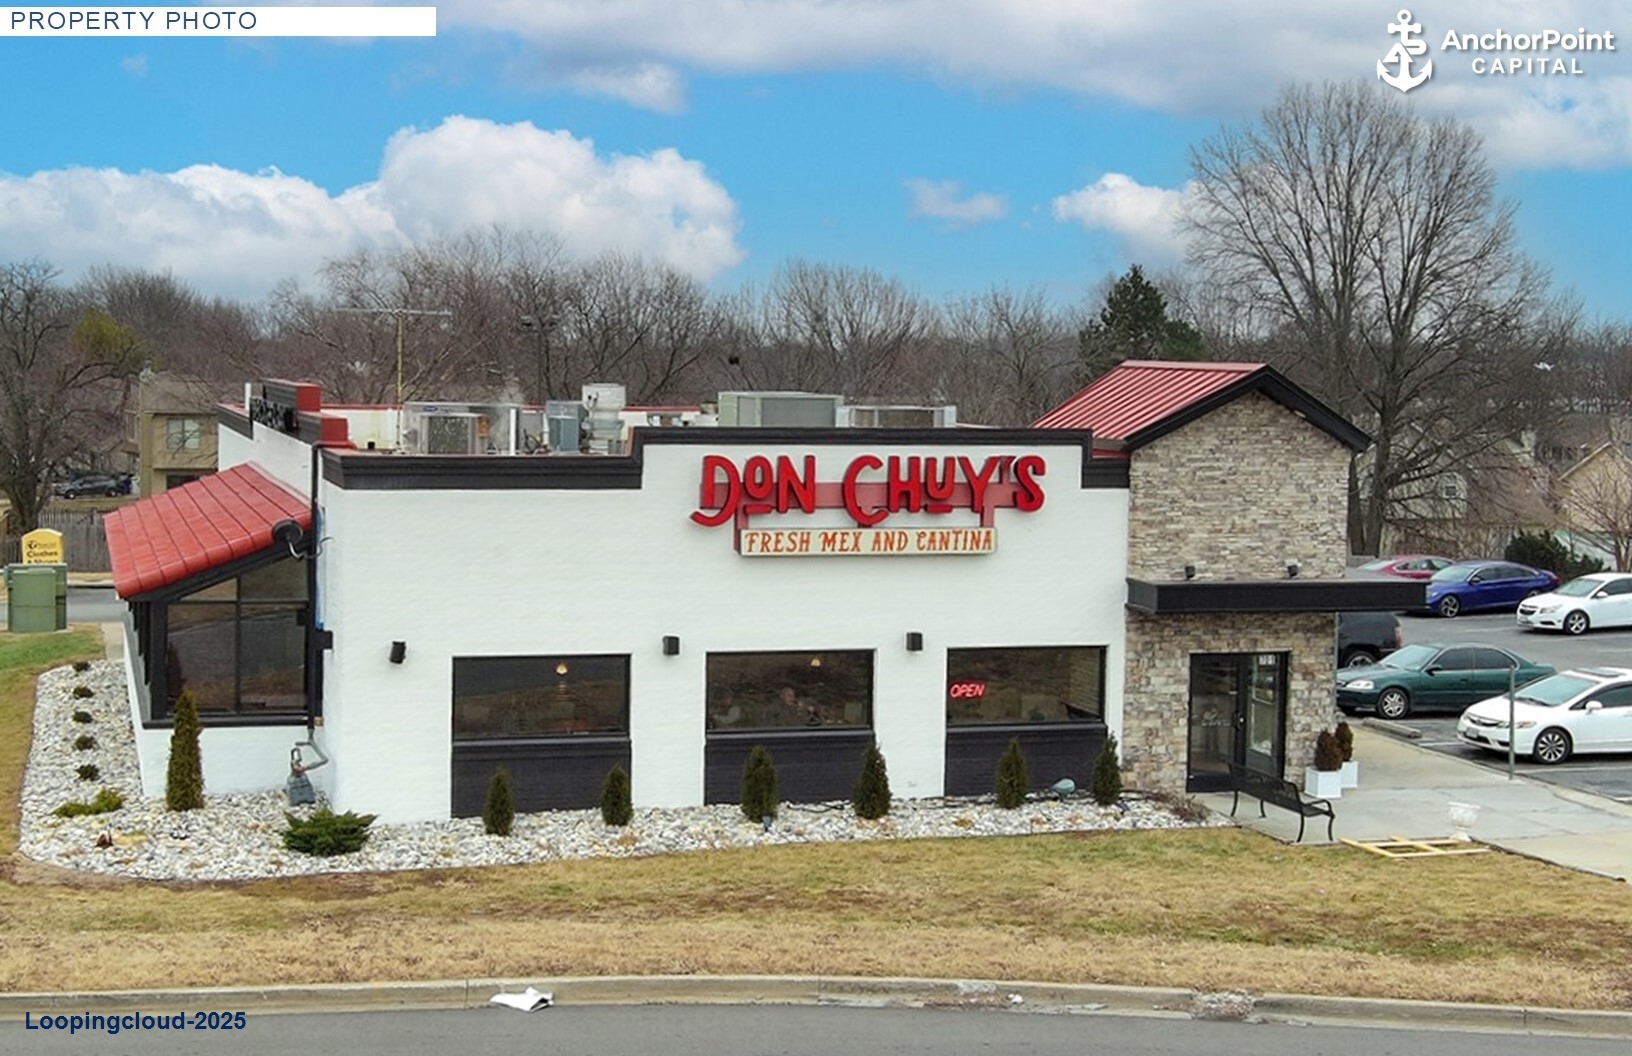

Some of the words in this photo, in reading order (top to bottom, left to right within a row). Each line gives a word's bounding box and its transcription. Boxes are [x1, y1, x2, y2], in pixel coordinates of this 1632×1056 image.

[745, 531, 812, 553] FRESH
[819, 531, 863, 552] MEX
[871, 531, 909, 552] AND
[916, 530, 992, 551] CANTINA
[950, 684, 985, 698] OPEN
